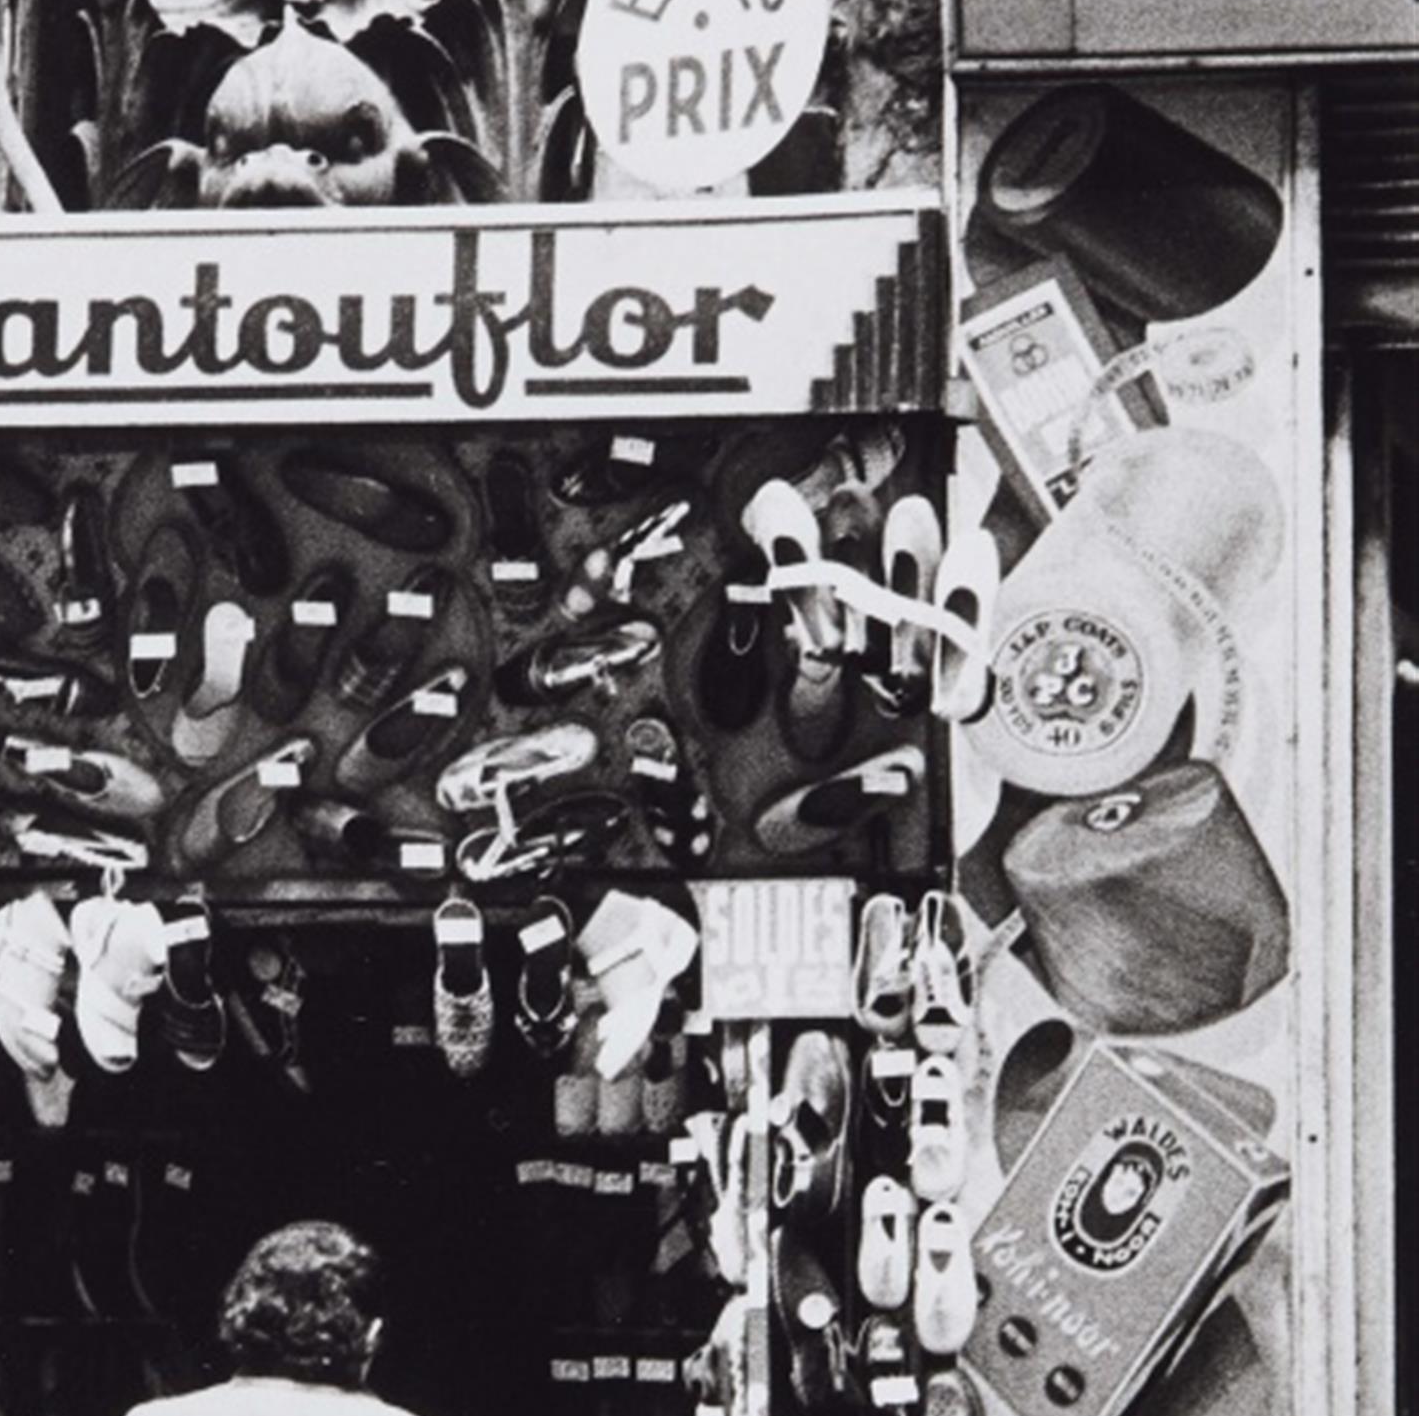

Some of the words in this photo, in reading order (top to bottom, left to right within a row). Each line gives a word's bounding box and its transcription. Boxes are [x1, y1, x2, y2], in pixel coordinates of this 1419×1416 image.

[619, 41, 786, 145] PRIX
[1062, 615, 1128, 659] COATS
[705, 884, 846, 967] SOLDES
[1103, 1115, 1191, 1183] WALDES
